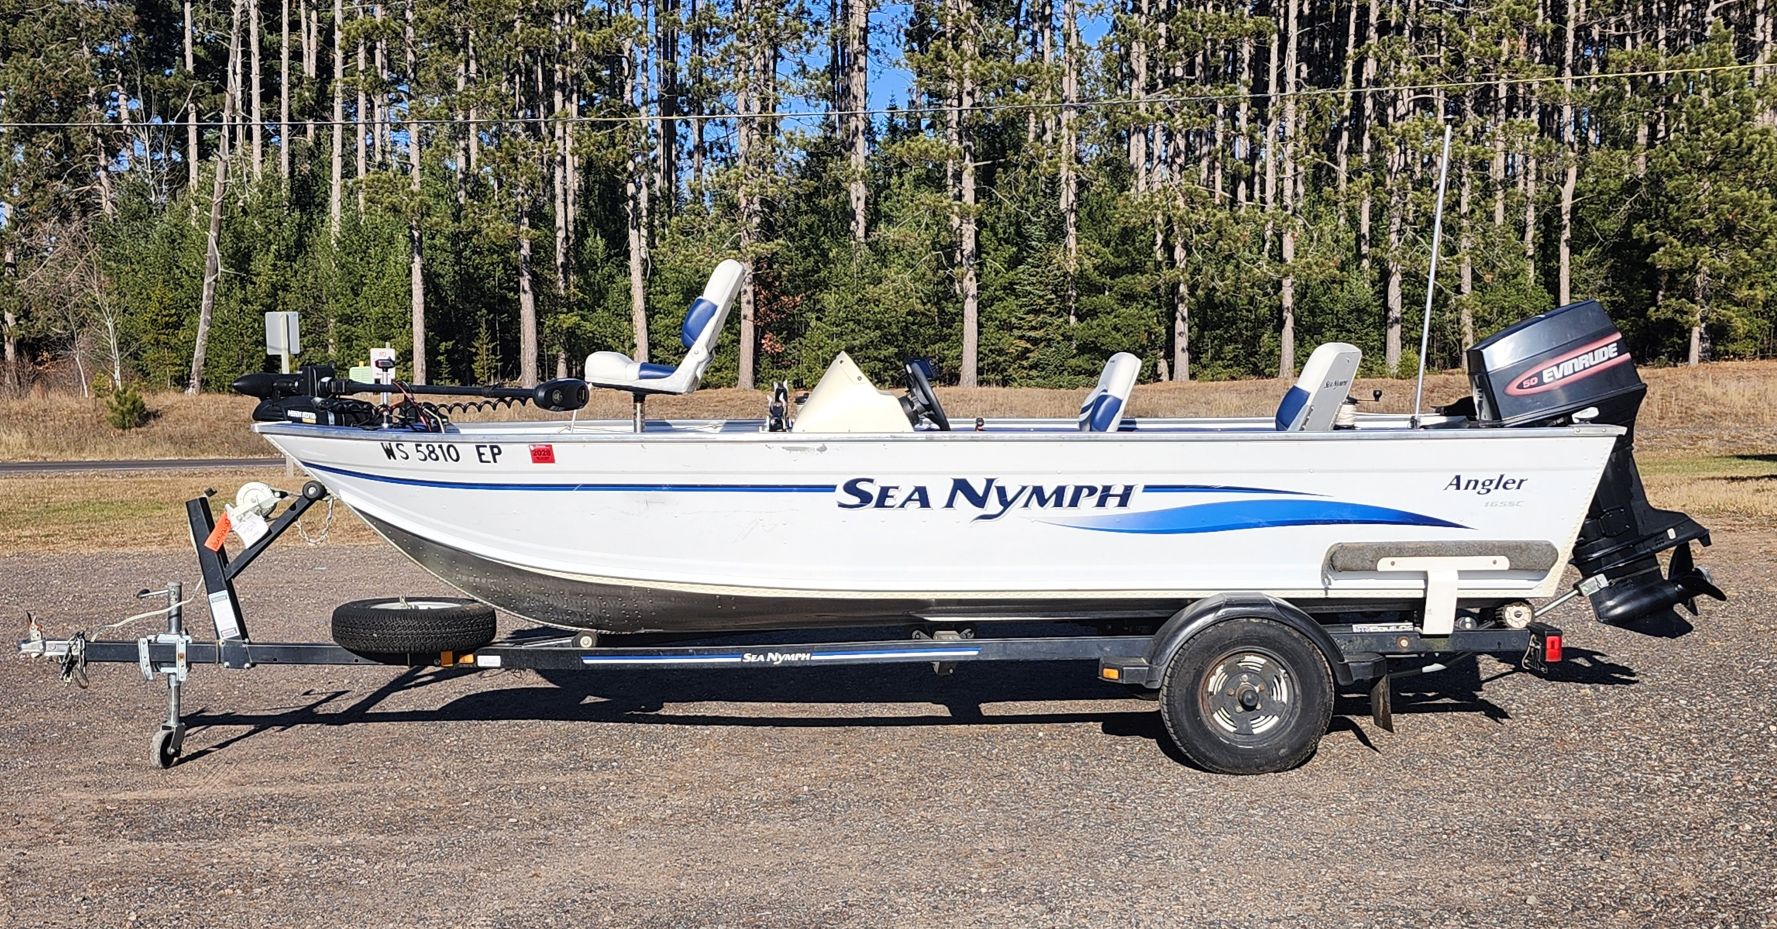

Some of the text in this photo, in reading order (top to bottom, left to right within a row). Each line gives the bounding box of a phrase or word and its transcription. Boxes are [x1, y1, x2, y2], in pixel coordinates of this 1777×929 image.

[1522, 343, 1619, 389] 50 EVINRUDE
[380, 442, 503, 464] WS 5810 EP
[1443, 473, 1529, 495] Angler
